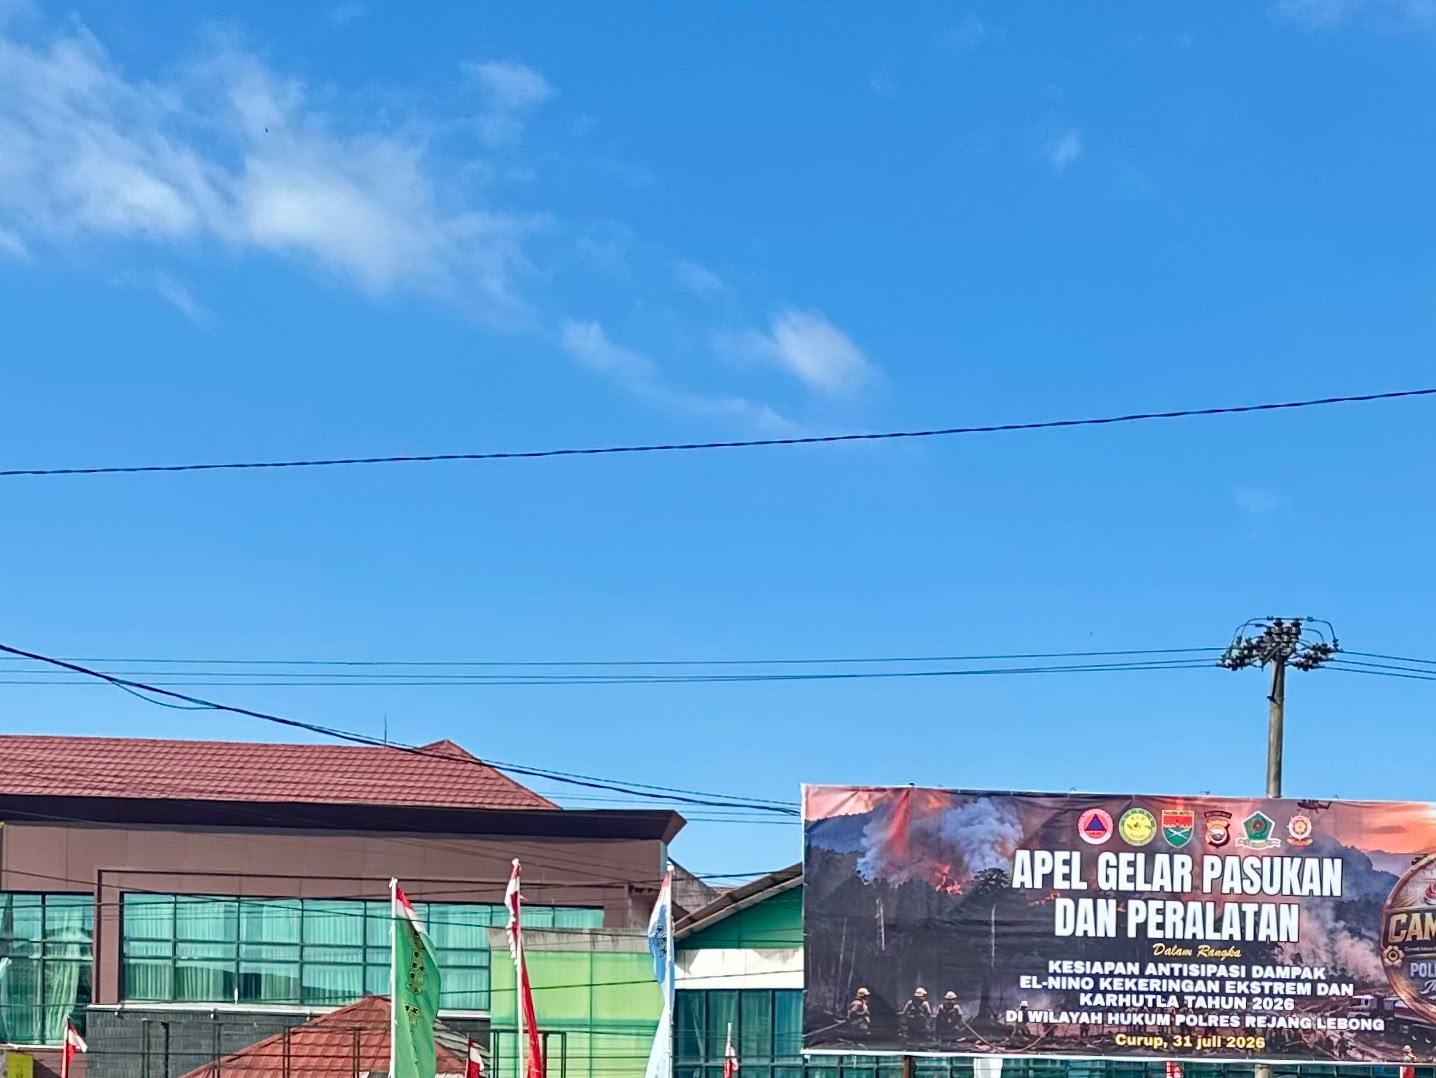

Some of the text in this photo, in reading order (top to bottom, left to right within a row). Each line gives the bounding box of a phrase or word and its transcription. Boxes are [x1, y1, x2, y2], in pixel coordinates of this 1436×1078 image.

[1012, 850, 1343, 897] APEL GELAR PASUKAN
[1055, 898, 1299, 943] DAN PERALATAN
[1152, 943, 1242, 960] Dalam Rangka
[1048, 960, 1326, 980] KESIAPAN ANTISIPASI DAMPAK
[1019, 975, 1354, 997] EL-NINO KEKERINGAN EKSTREM DAN
[1079, 992, 1294, 1011] KARHUTLA TAHUN 2026
[1005, 1010, 1384, 1031] DI WILAYAH HUKUM POLRES REJANG LEBONG
[1115, 1032, 1265, 1050] Curup, 31 juli 2026
